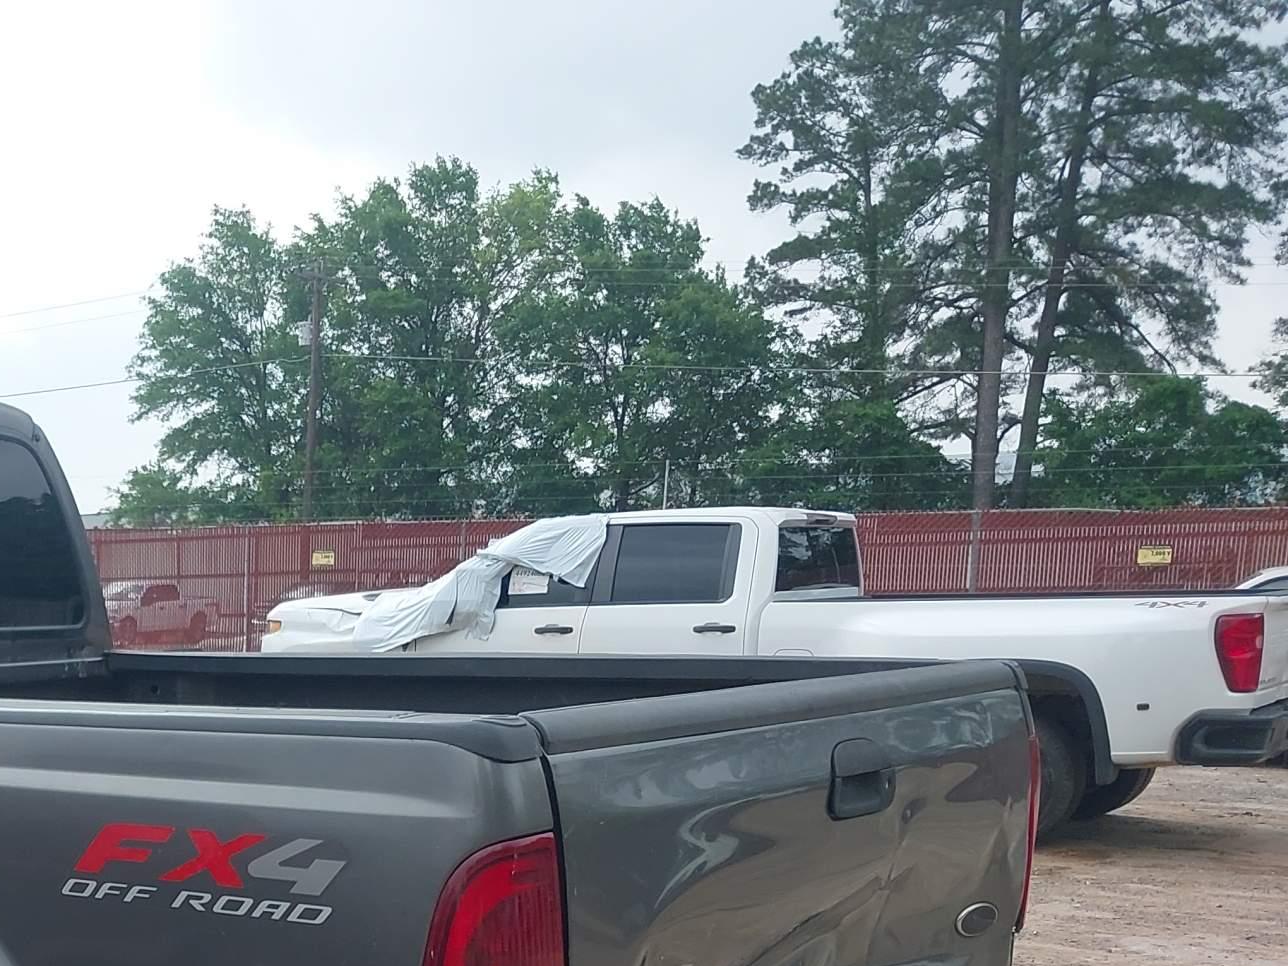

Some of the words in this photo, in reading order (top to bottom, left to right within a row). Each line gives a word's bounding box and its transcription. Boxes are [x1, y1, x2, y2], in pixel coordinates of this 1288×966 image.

[73, 822, 348, 897] FX4
[62, 878, 158, 902] OFF
[171, 890, 333, 925] ROAD
